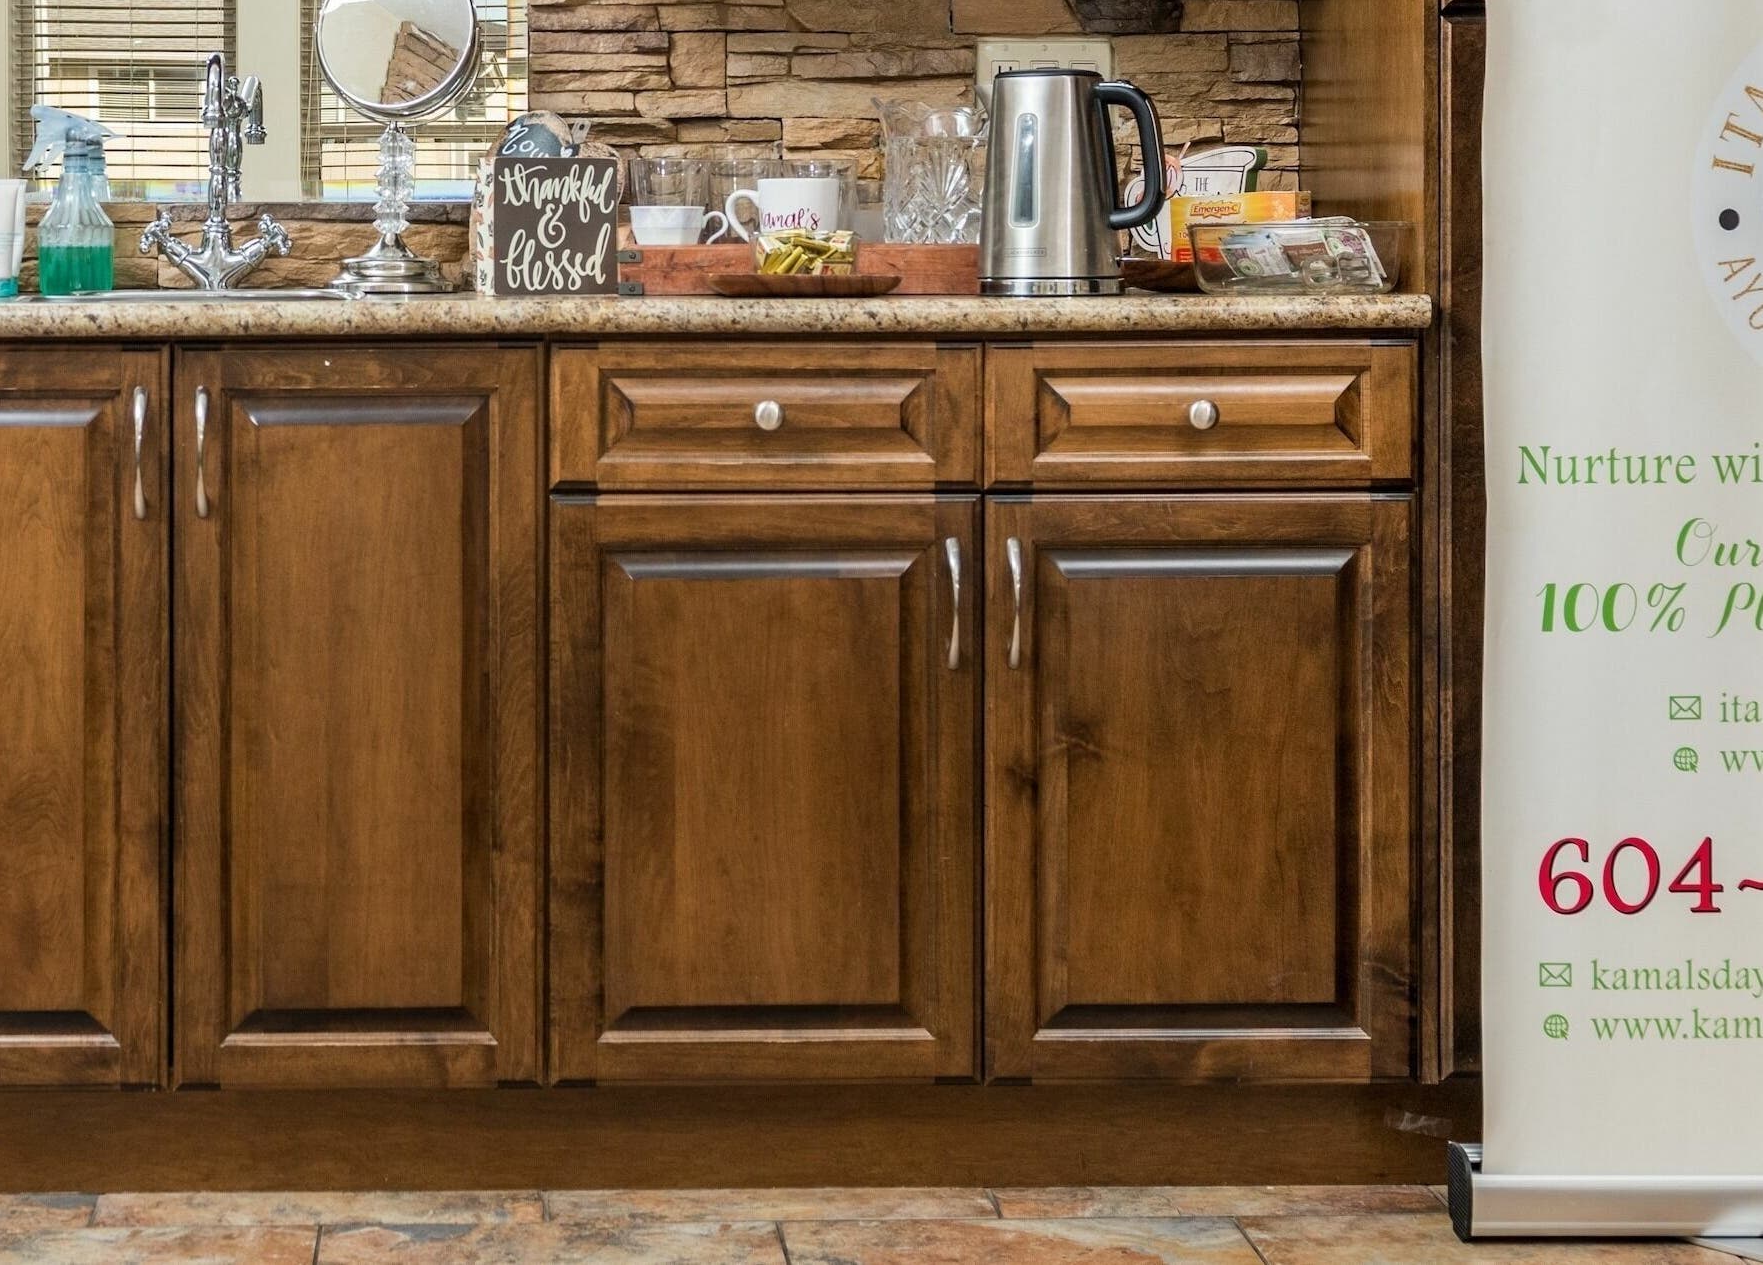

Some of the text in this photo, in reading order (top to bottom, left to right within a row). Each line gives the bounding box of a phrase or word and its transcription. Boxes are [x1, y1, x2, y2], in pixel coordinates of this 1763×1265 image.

[499, 163, 614, 223] thankful
[1193, 204, 1237, 215] Emergen-C
[537, 203, 566, 248] &
[762, 208, 820, 230] amal's
[499, 223, 611, 291] blessed
[1518, 446, 1696, 484] Nurture
[1677, 518, 1763, 566] Our
[1536, 582, 1687, 633] 100%
[1720, 692, 1762, 723] ita
